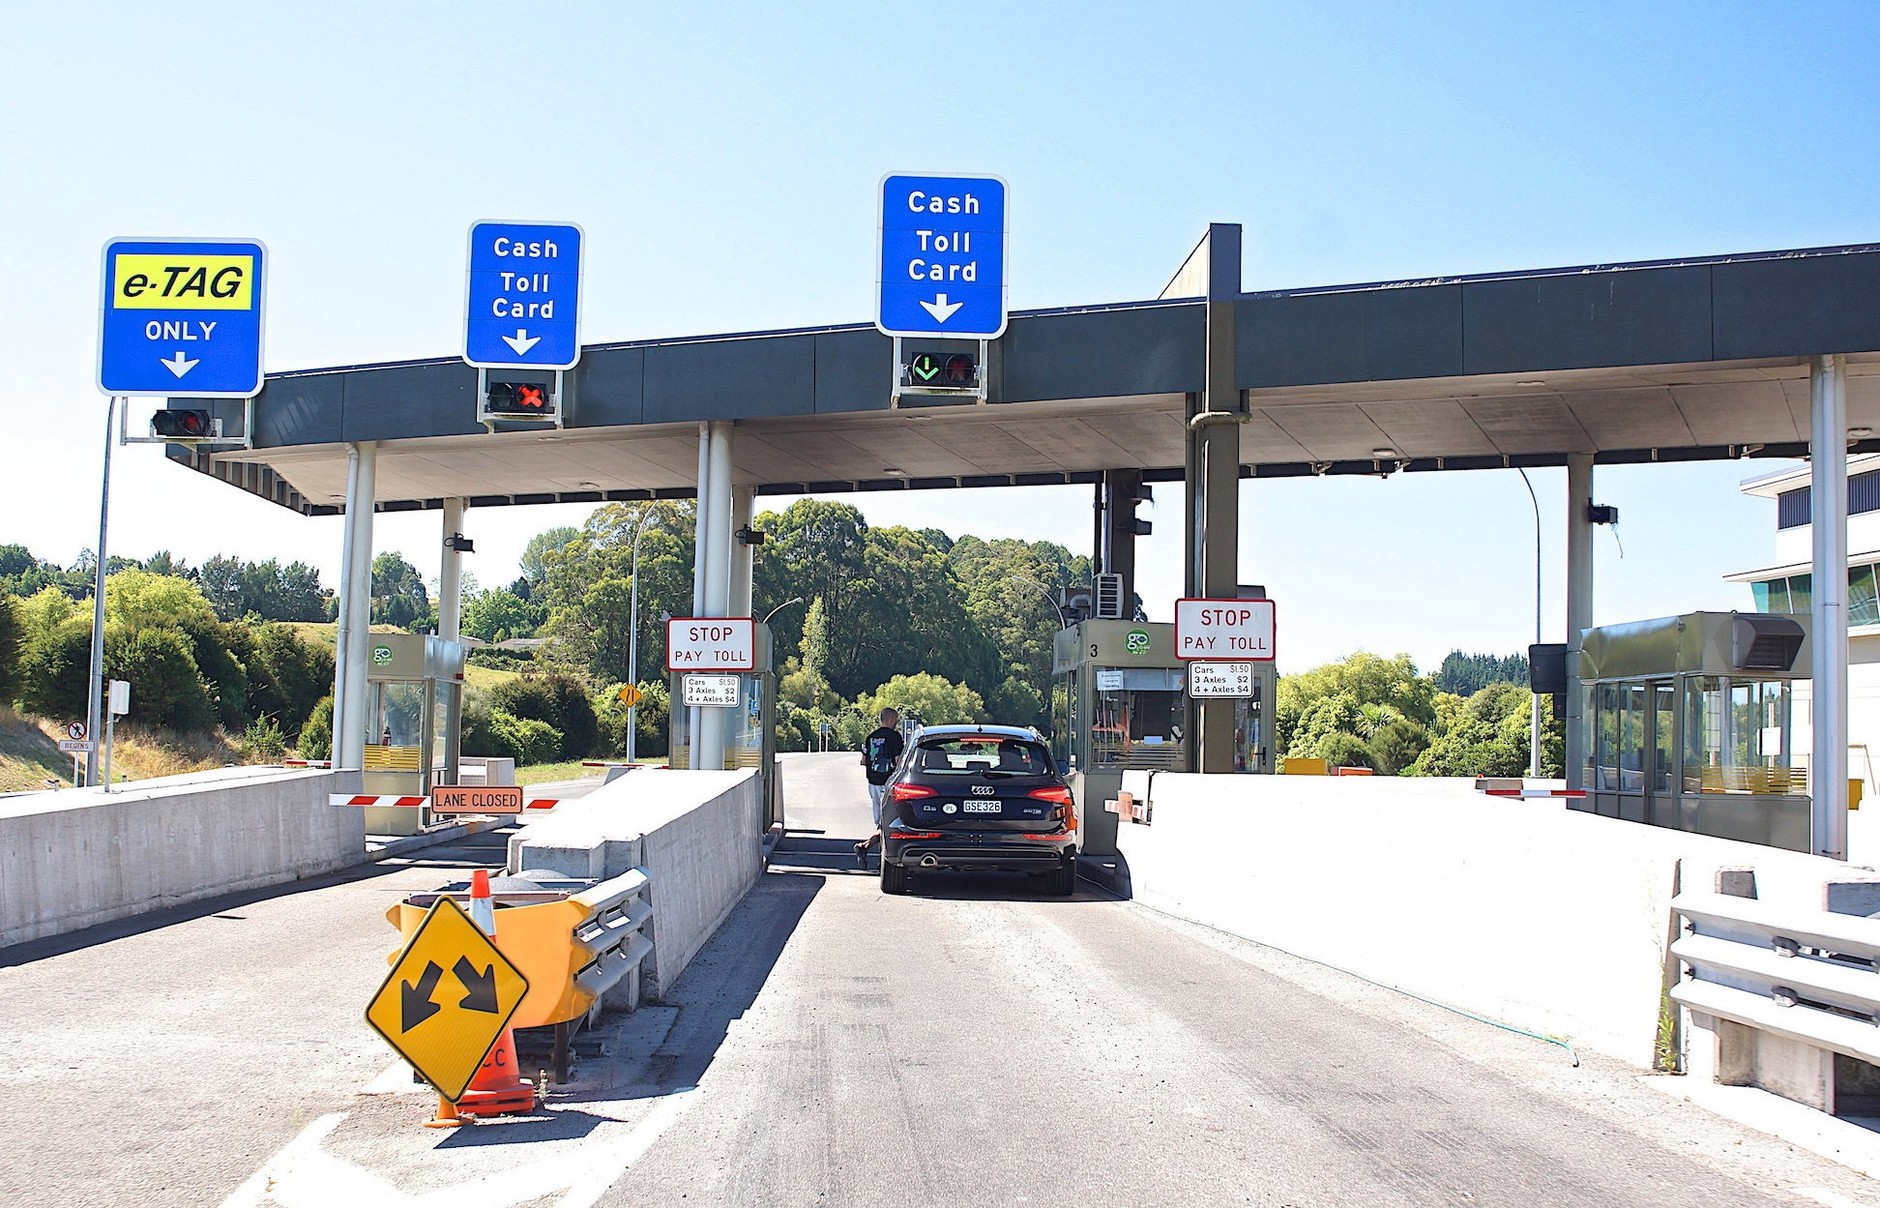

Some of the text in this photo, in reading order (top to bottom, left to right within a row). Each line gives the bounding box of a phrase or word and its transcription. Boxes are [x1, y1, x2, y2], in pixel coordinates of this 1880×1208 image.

[908, 190, 980, 214] Cash
[493, 237, 558, 259] Cash
[916, 230, 970, 253] Toll
[908, 259, 977, 282] Card
[122, 265, 244, 299] e-TAG
[500, 272, 549, 293] Toll
[492, 297, 554, 319] Card
[145, 320, 217, 342] ONLY
[1201, 609, 1251, 626] STOP
[689, 627, 733, 642] STOP
[1090, 644, 1098, 657] 3
[1184, 637, 1267, 650] PAY TOLL
[675, 651, 747, 662] PAY TOLL
[1194, 664, 1249, 674] Cars $1.50
[688, 678, 706, 686] Cars
[1237, 675, 1249, 683] $2
[725, 687, 735, 695] $2
[1211, 685, 1235, 693] Axles
[1237, 685, 1249, 693] $4
[725, 695, 735, 703] $4
[64, 742, 89, 750] BEGINS
[435, 793, 518, 808] LANE CLOSED
[965, 802, 1000, 811] GSE326
